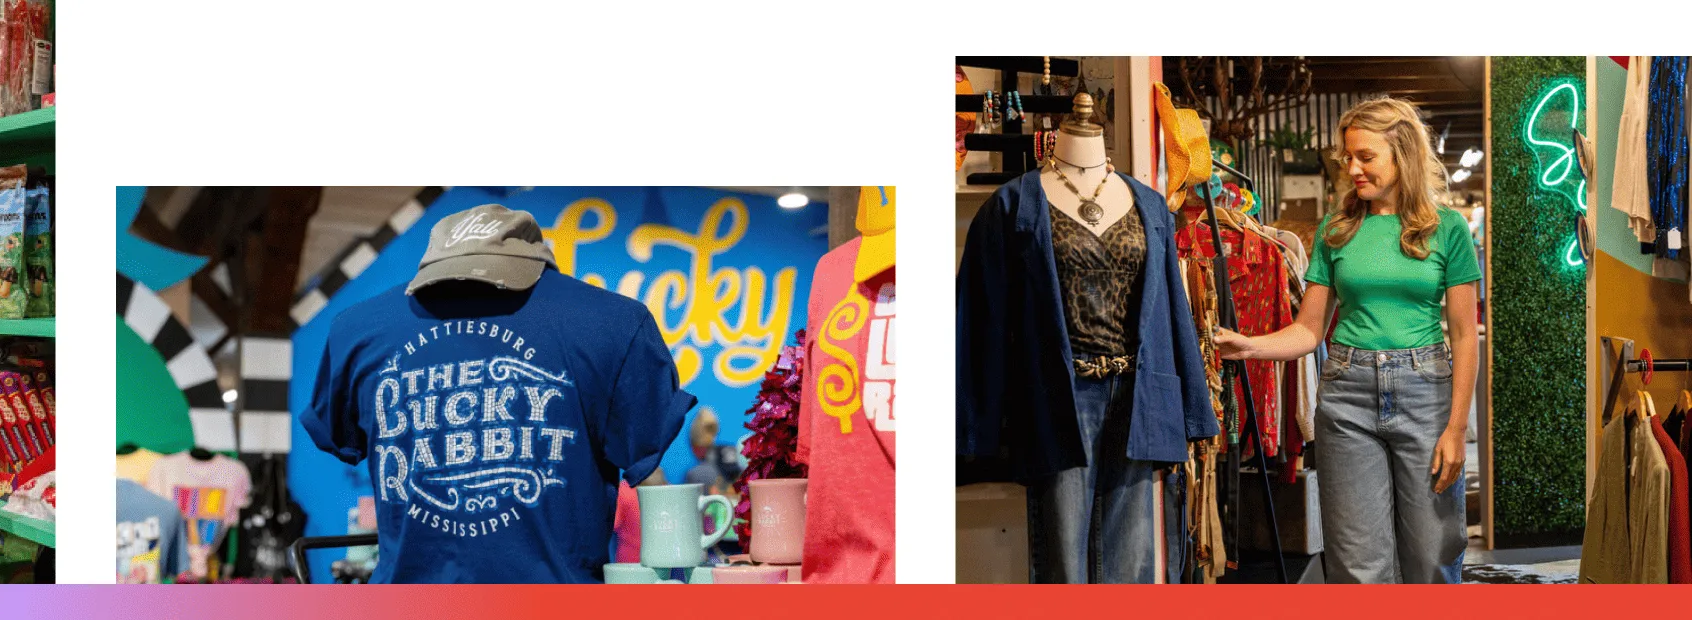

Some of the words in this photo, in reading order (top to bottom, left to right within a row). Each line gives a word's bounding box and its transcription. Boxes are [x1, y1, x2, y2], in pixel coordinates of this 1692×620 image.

[445, 212, 503, 248] Y'all
[404, 320, 536, 361] HATTIESBURG
[401, 359, 485, 396] THE
[375, 377, 564, 439] LUCKY
[374, 426, 576, 502] RABBIT
[407, 504, 521, 538] MISSISSIPPI
